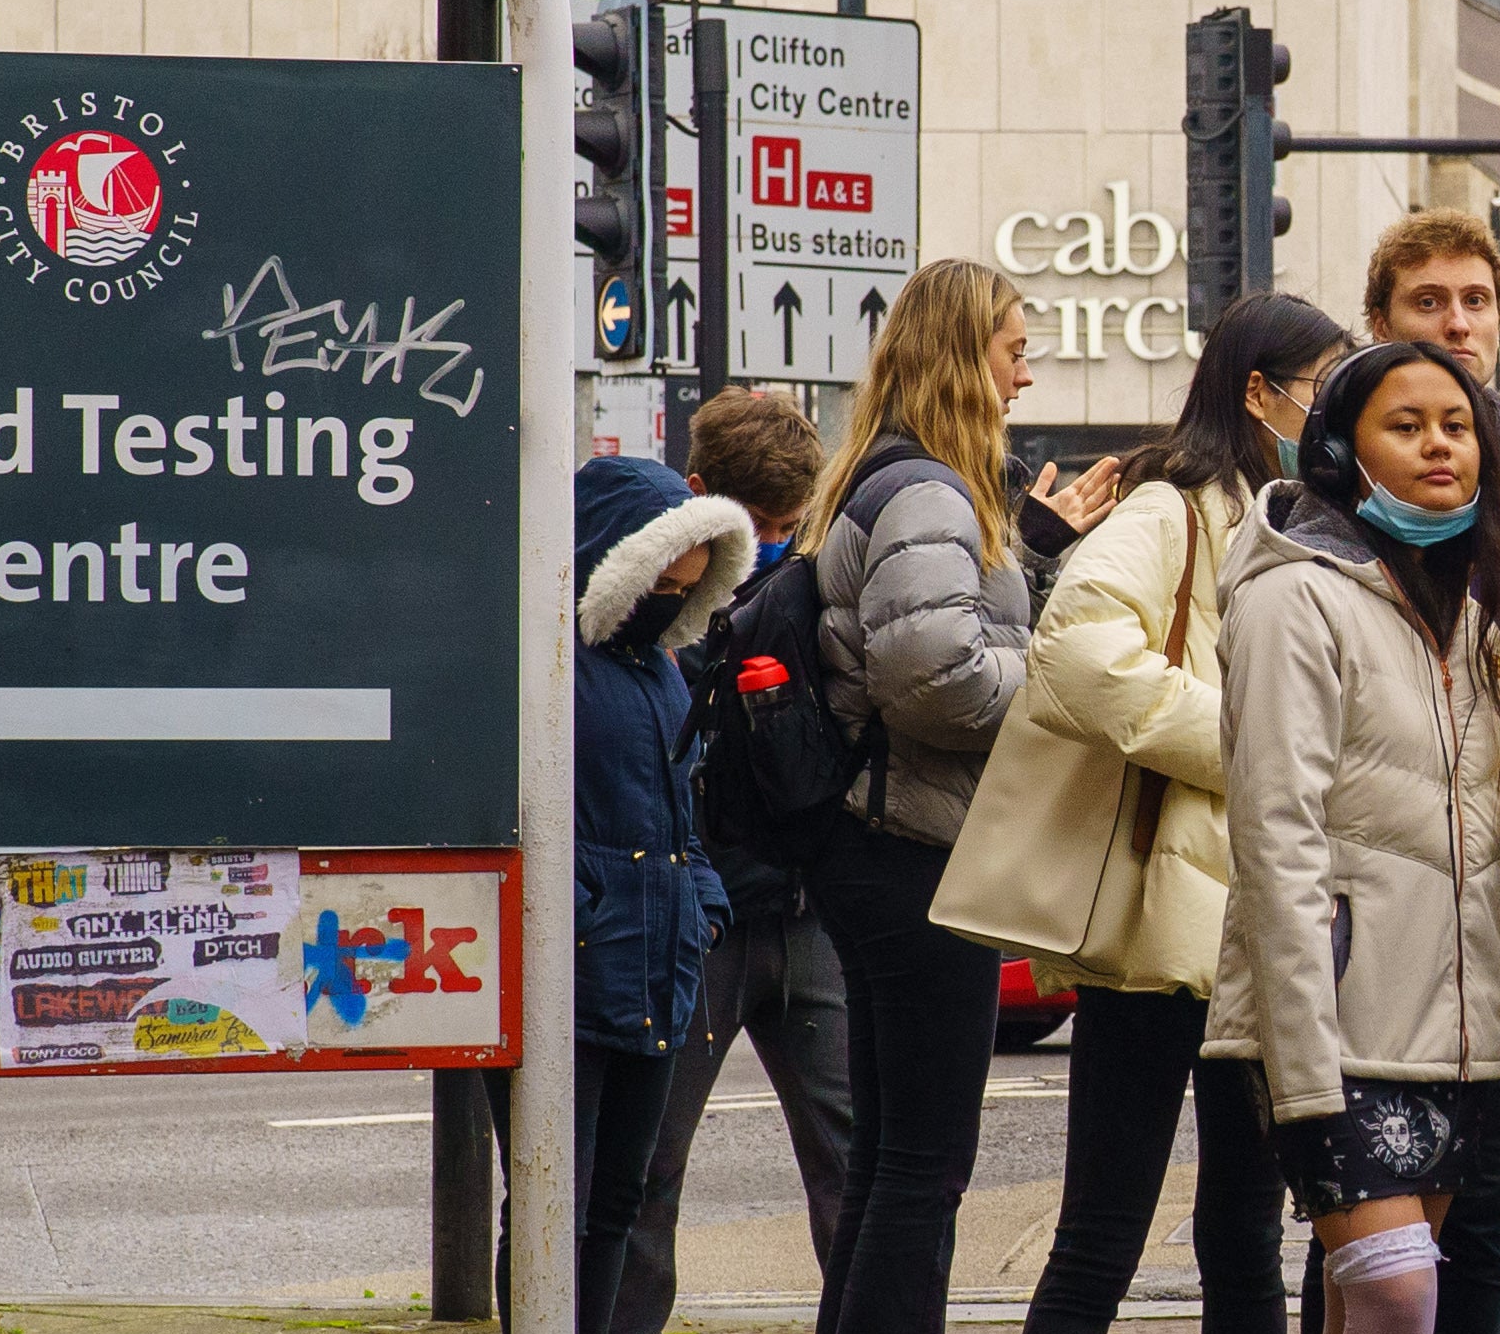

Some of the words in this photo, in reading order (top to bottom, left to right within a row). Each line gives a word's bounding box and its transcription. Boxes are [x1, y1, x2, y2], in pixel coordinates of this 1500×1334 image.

[751, 35, 845, 67] Clifton
[751, 83, 806, 118] City
[818, 87, 911, 120] Centre
[0, 92, 186, 165] BRISTOL
[759, 146, 794, 202] H
[814, 179, 866, 205] A&E
[751, 223, 801, 253] Bus
[812, 228, 905, 259] station
[994, 180, 1190, 276] cab
[65, 211, 199, 305] COUNCIL
[62, 391, 415, 505] Testing
[106, 861, 162, 893] THING
[211, 854, 252, 864] BRISTOL
[12, 867, 87, 905] THAT
[74, 916, 123, 934] ANI
[144, 911, 229, 932] KLANG
[16, 951, 75, 970] AUDIO
[78, 946, 155, 967] GUTTER
[205, 940, 262, 958] D'TCH
[20, 1048, 59, 1060] TONY
[60, 1046, 99, 1058] LOCO
